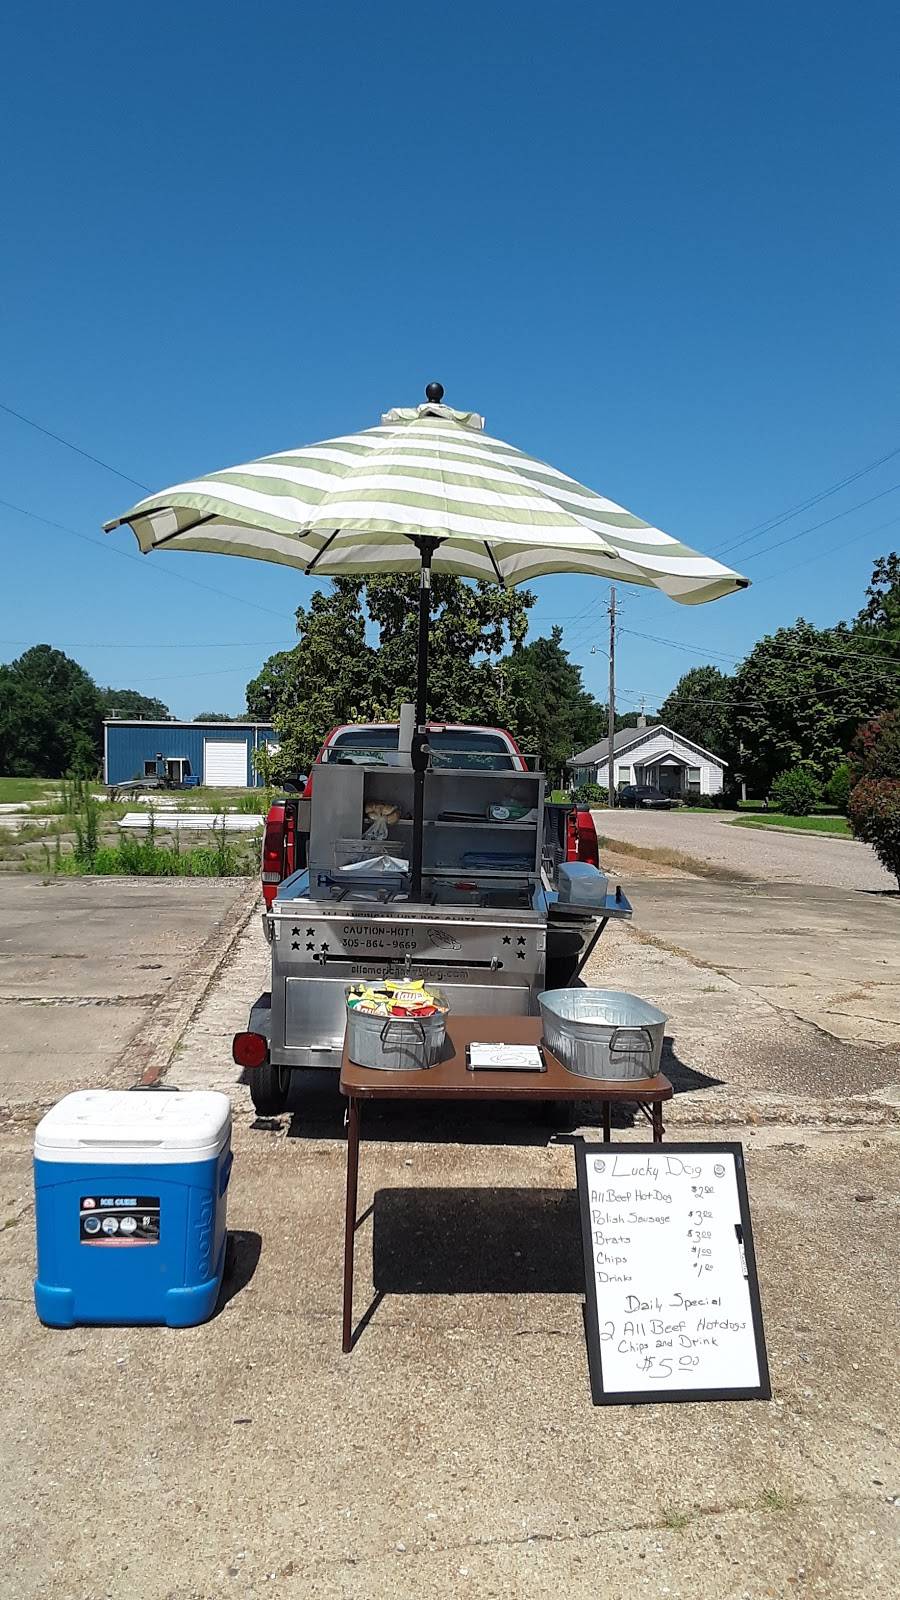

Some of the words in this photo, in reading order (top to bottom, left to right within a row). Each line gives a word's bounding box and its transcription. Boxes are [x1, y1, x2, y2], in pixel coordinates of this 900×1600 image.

[343, 926, 414, 937] CAUTION-HOT!
[342, 938, 417, 949] 305-864-9669
[612, 1156, 659, 1180] Lucky
[664, 1156, 702, 1179] Dog
[591, 1190, 604, 1203] All
[592, 1209, 625, 1225] Polish
[627, 1212, 670, 1224] Sausage
[593, 1231, 631, 1245] Brats
[597, 1252, 627, 1265] Chips
[597, 1272, 632, 1283] Drinks
[624, 1295, 663, 1313] Daily
[669, 1292, 721, 1311] Special
[600, 1321, 615, 1341] 2
[623, 1321, 646, 1336] All
[650, 1319, 686, 1334] Beef
[697, 1317, 746, 1332] Hotdogs
[617, 1340, 649, 1354] Chips
[655, 1340, 673, 1348] and
[679, 1335, 719, 1348] Drink
